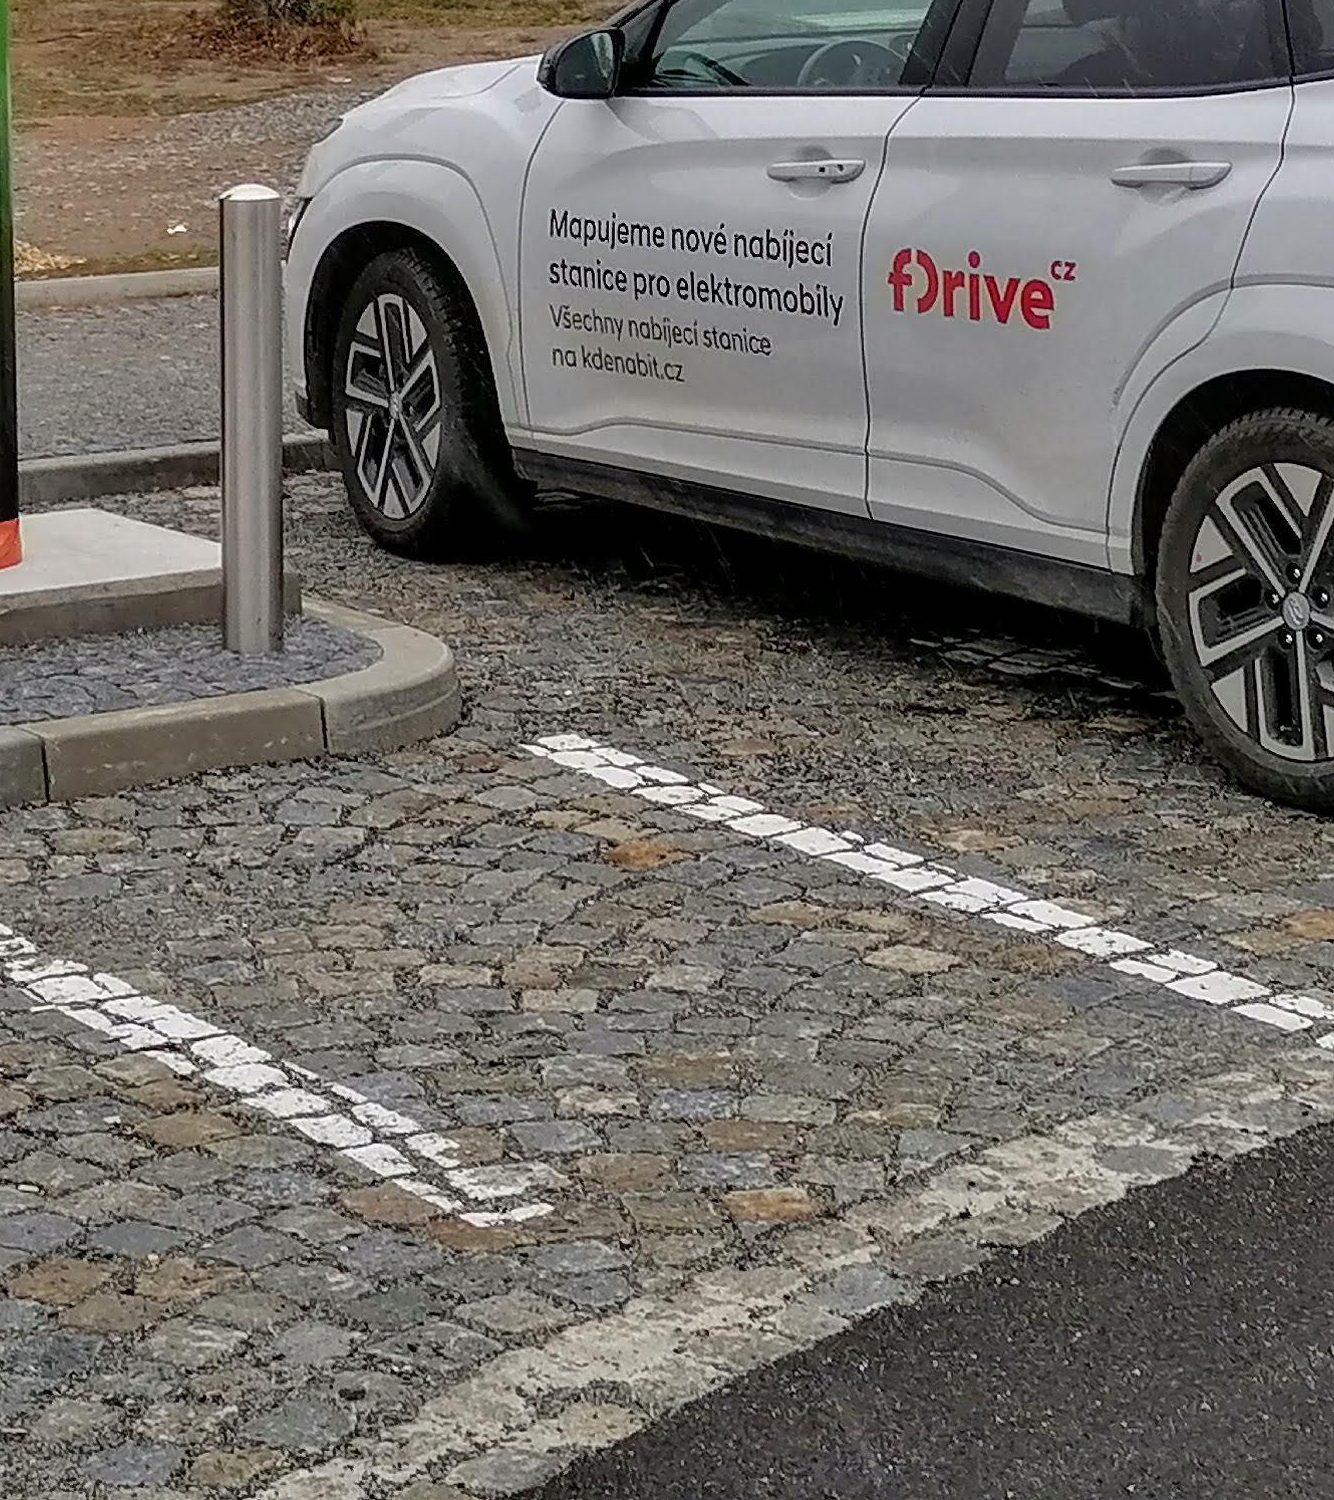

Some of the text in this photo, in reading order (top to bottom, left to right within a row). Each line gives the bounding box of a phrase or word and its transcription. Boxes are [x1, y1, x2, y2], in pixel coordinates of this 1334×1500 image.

[549, 209, 833, 268] Mapujeme nové nabíjecí
[549, 259, 844, 327] stanice pro elektromobily
[549, 304, 772, 357] Všechny nabíjecí stanice
[552, 345, 685, 383] na kdenabit.cz
